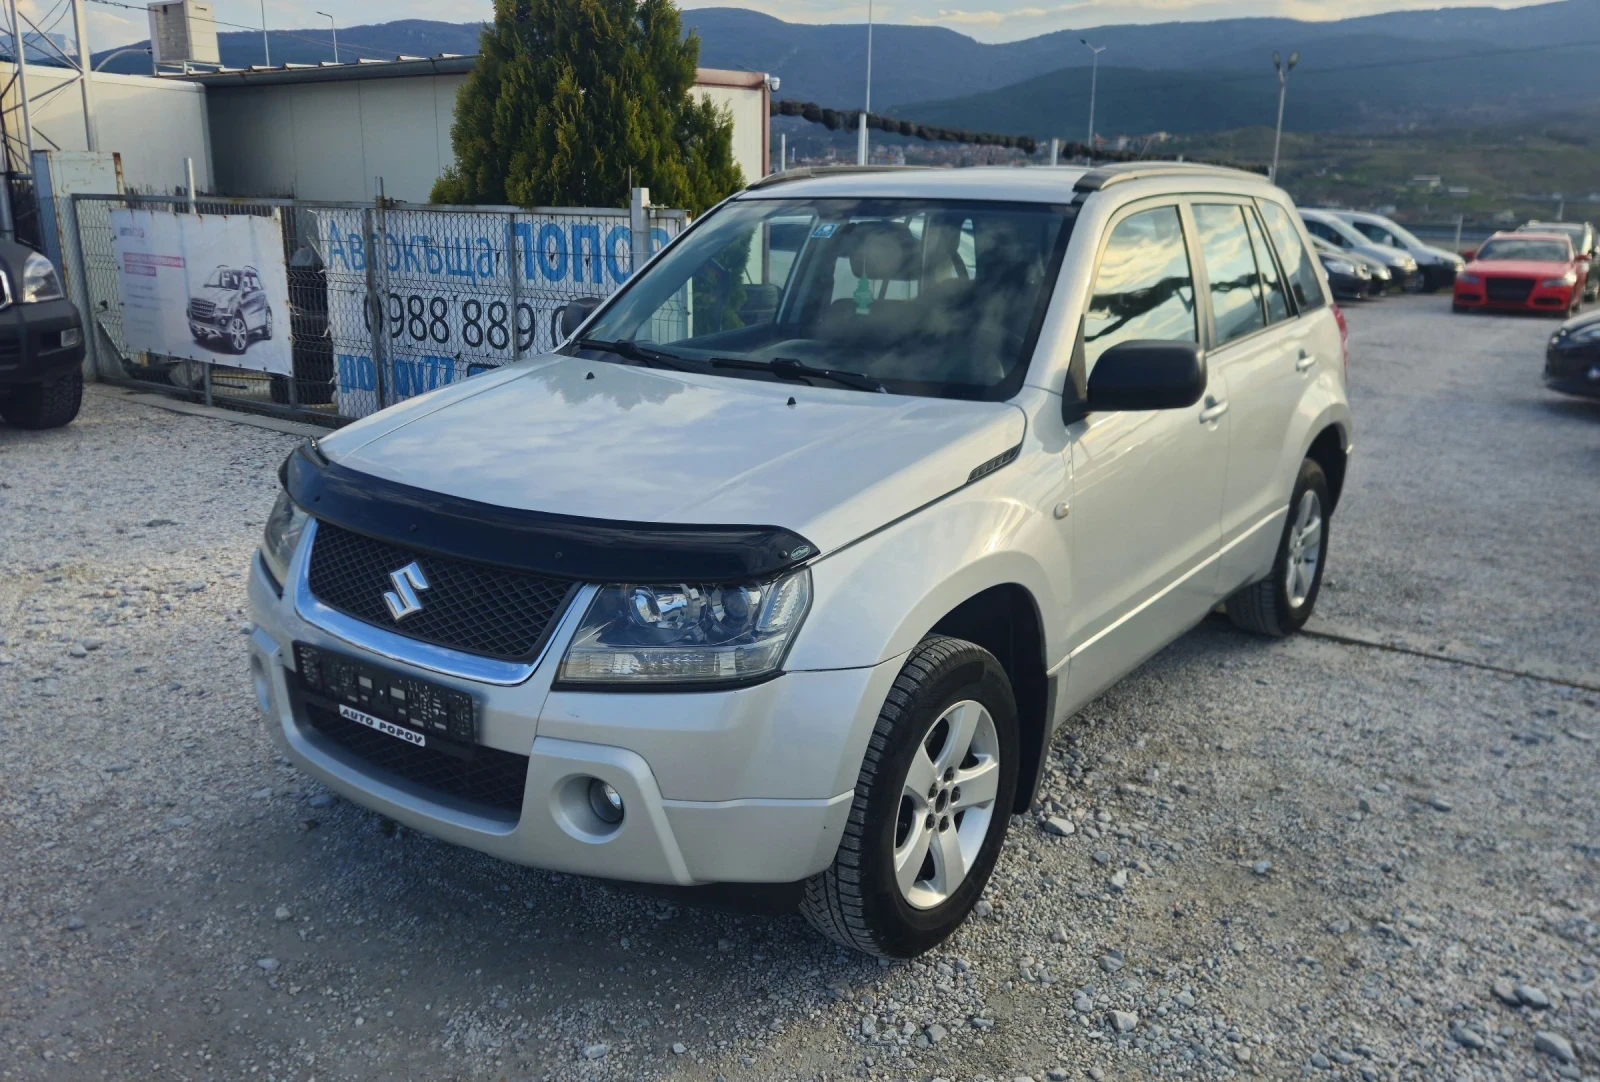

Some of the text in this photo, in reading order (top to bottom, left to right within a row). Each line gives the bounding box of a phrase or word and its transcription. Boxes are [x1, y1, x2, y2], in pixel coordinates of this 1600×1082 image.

[364, 292, 450, 344] 0988
[462, 298, 536, 352] 889
[343, 709, 423, 744] AUTO POPOV
